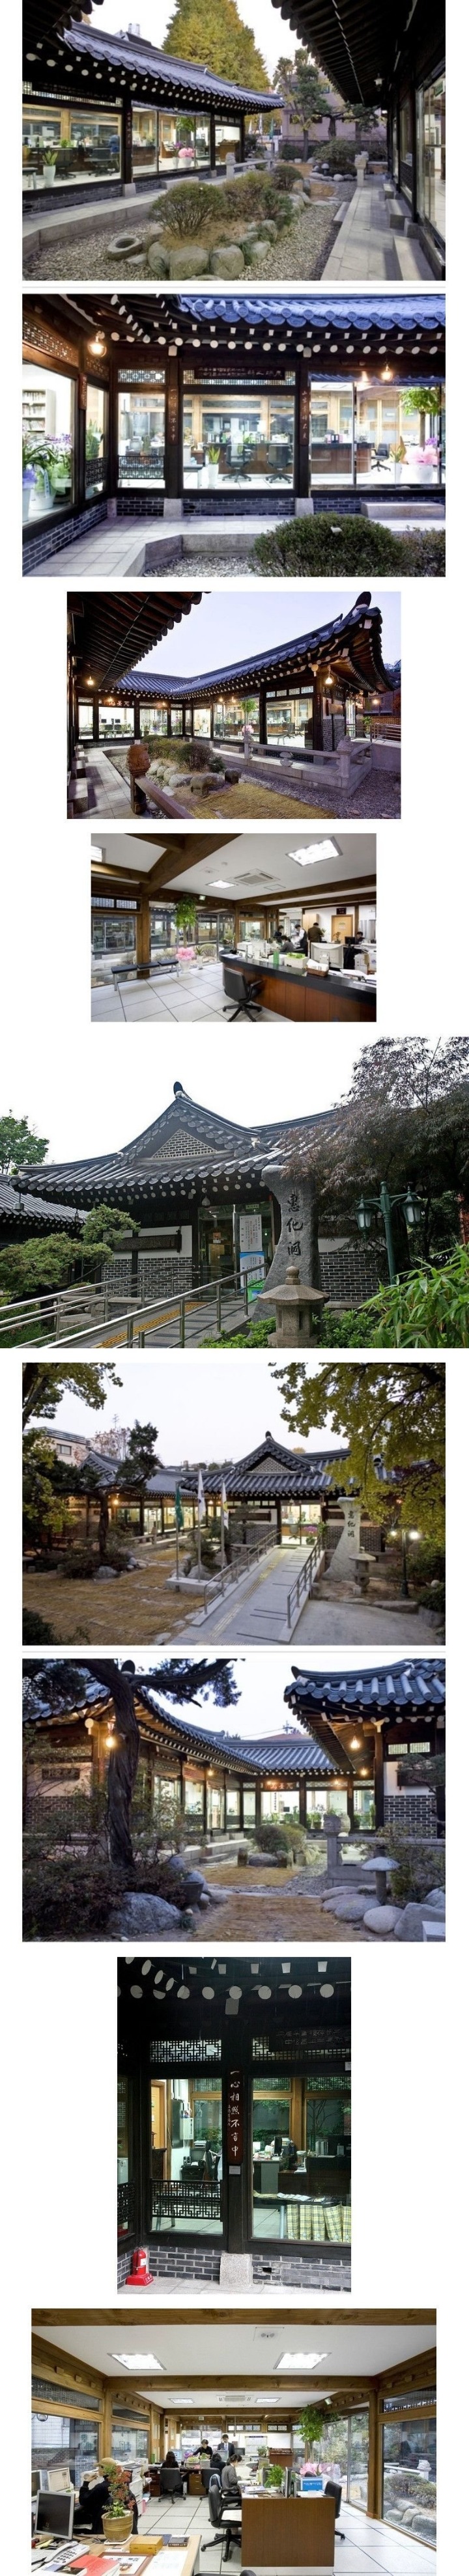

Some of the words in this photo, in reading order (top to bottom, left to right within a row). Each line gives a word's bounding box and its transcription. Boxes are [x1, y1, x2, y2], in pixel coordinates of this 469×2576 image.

[286, 1194, 303, 1256] 惠化洞
[230, 2071, 240, 2157] 一心相照不言中
